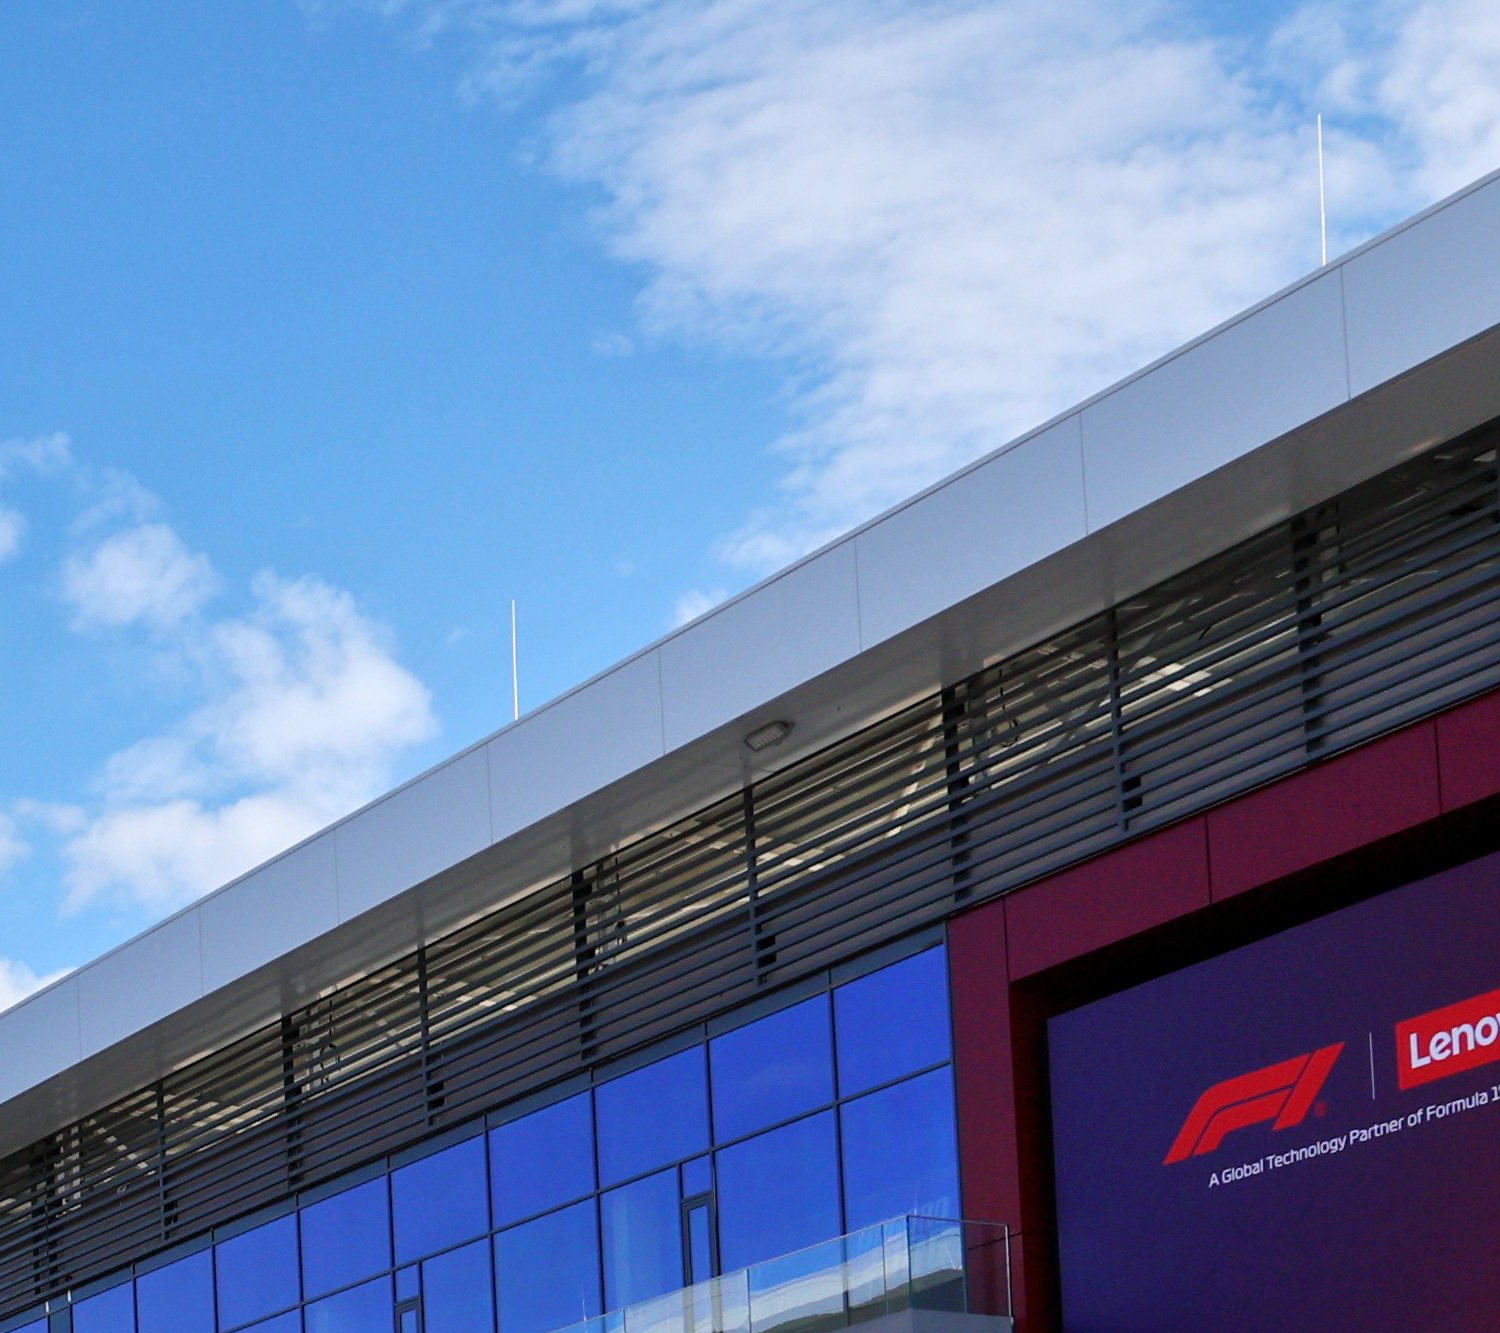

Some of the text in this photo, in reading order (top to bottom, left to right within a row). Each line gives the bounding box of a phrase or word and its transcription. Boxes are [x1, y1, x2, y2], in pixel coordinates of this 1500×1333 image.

[1208, 1173, 1220, 1188] A
[1221, 1159, 1264, 1184] Global
[1266, 1135, 1347, 1168] Technology
[1349, 1117, 1404, 1144] Partner
[1407, 1111, 1423, 1126] of
[1426, 1091, 1488, 1121] Formula
